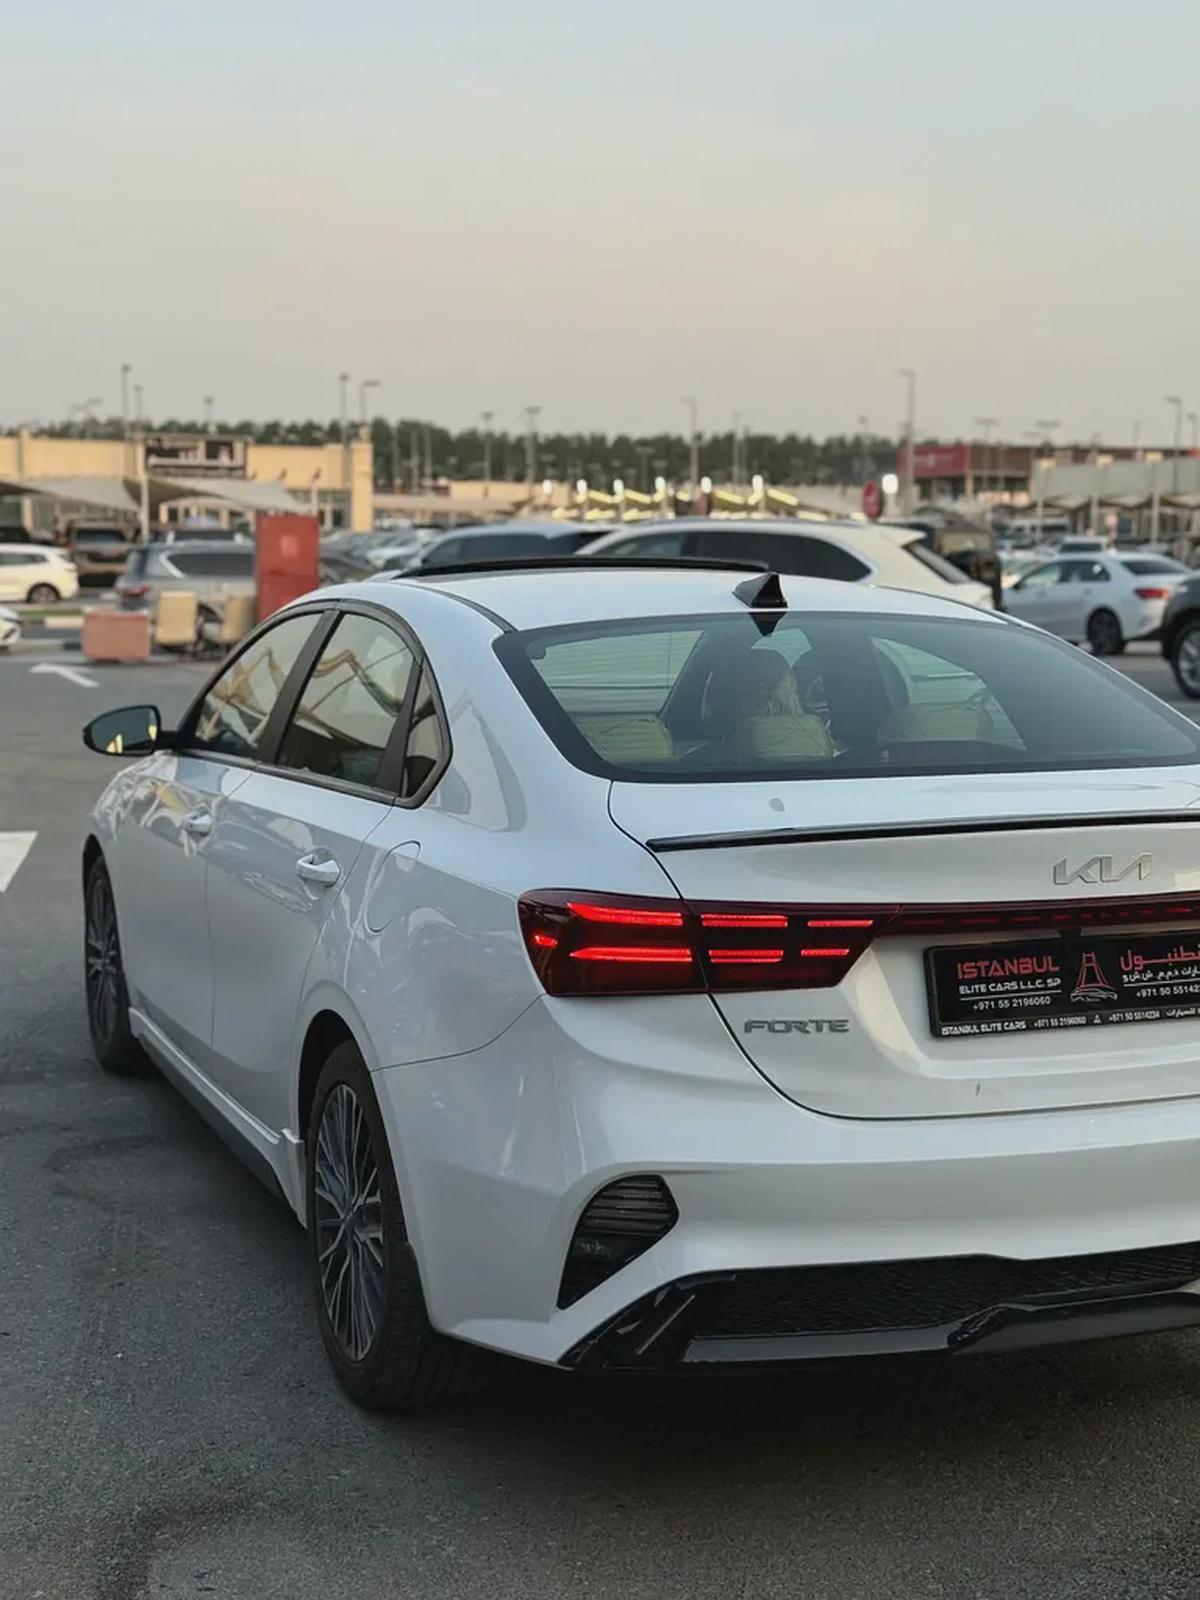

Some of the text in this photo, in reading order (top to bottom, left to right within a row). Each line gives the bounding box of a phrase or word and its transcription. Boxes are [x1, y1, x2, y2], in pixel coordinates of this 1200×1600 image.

[1051, 851, 1152, 885] KIA
[957, 955, 1060, 980] ISTANBUL
[959, 983, 987, 995] ELITE
[988, 980, 1018, 992] CARS
[1136, 988, 1157, 998] +971
[1159, 987, 1171, 996] 50
[972, 1000, 995, 1011] +971
[997, 999, 1010, 1009] 55
[744, 1019, 850, 1034] FORTE
[941, 1024, 980, 1036] ISTANBUL
[980, 1022, 1002, 1032] ELITE
[1004, 1020, 1027, 1031] CARS
